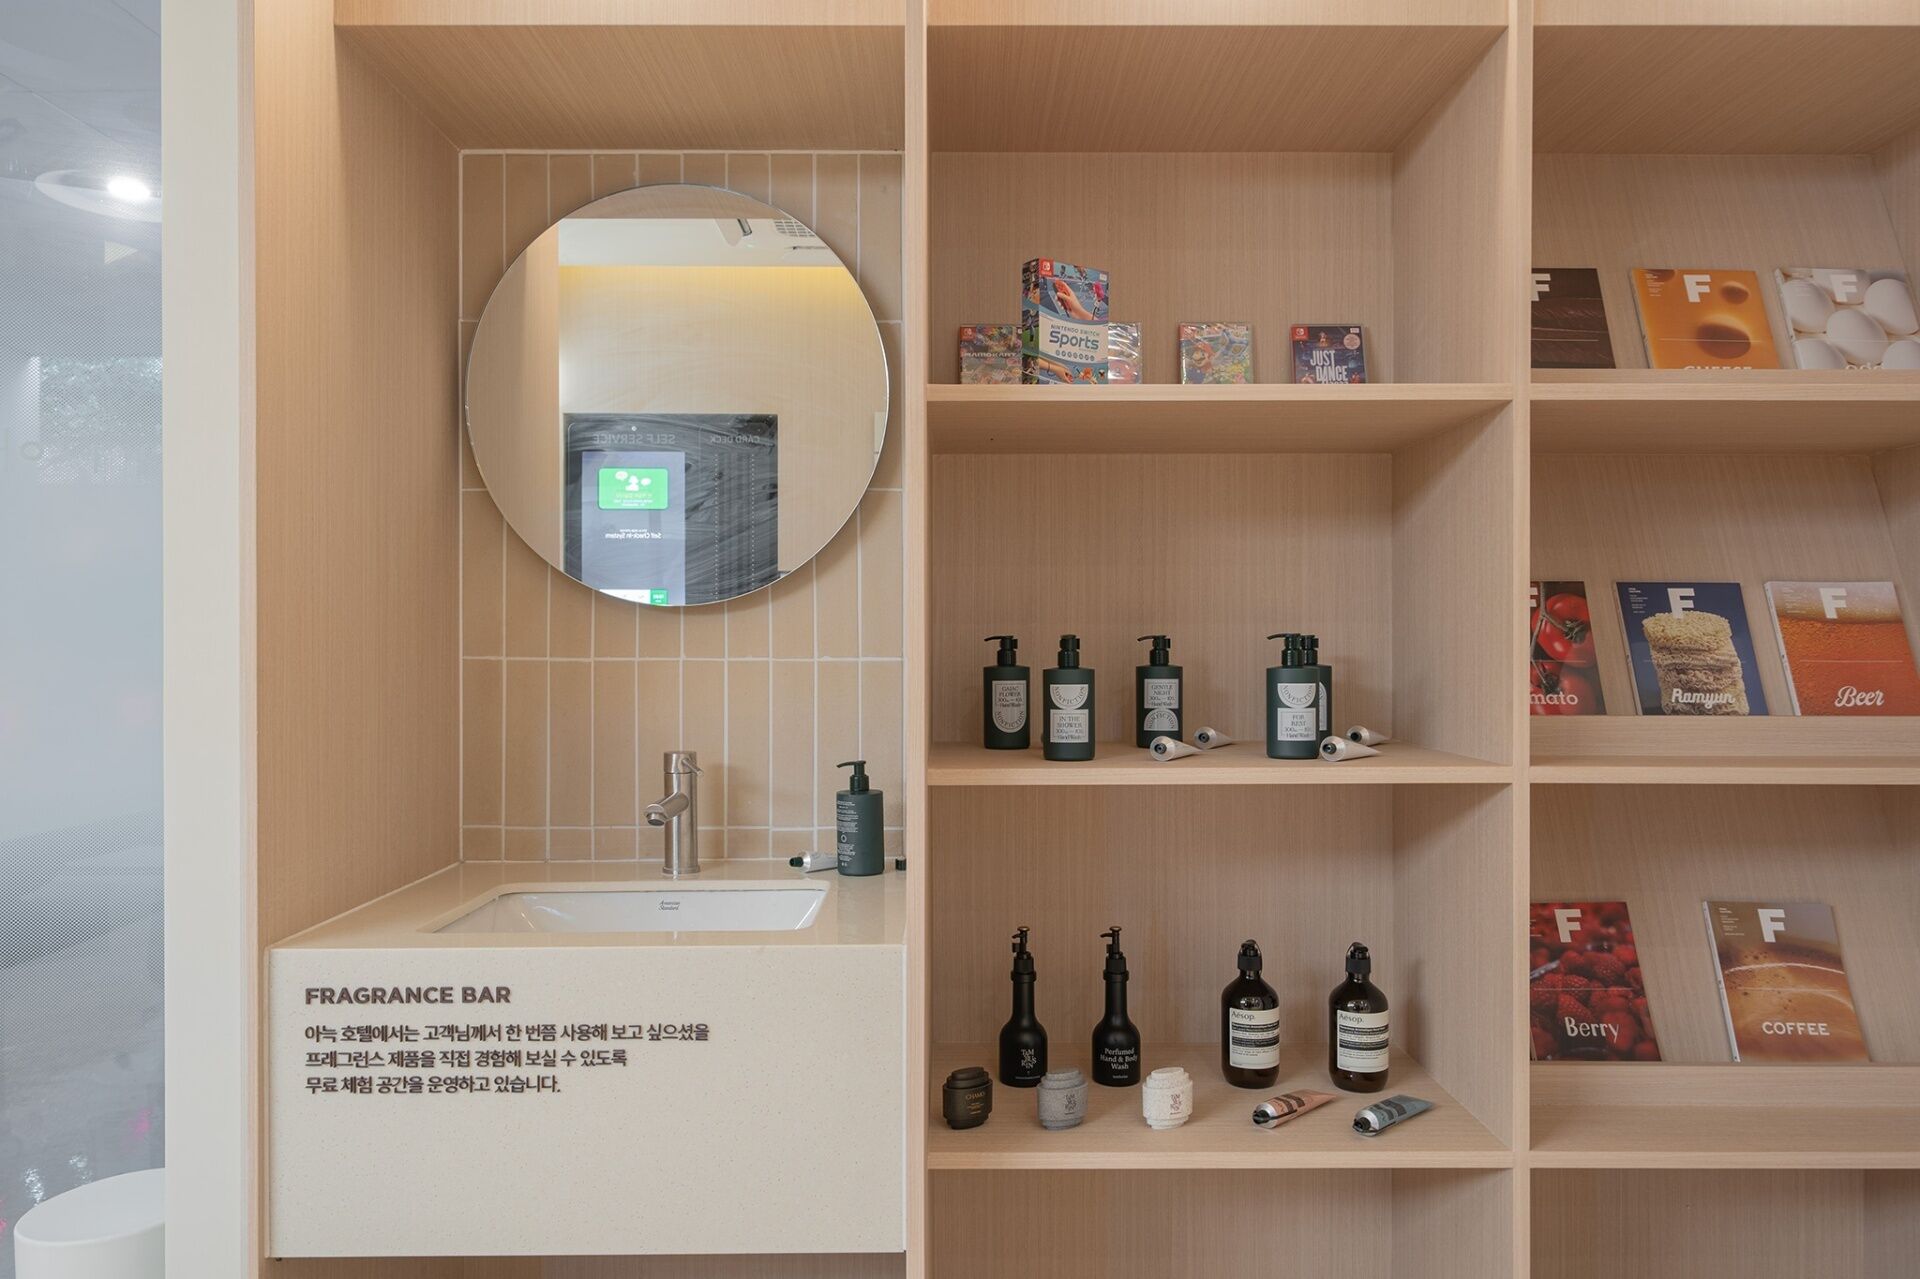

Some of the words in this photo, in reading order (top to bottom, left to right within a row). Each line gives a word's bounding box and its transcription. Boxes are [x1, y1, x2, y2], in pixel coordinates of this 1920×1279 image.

[1683, 275, 1711, 302] F
[1829, 274, 1858, 302] F
[1049, 331, 1099, 350] Sports
[1310, 350, 1335, 366] JUST
[1316, 366, 1349, 382] DANCE
[1667, 588, 1695, 619] F
[1819, 588, 1847, 619] F
[1672, 688, 1736, 709] Ramyun
[1835, 686, 1884, 707] Beer
[1554, 909, 1582, 942] F
[1757, 909, 1786, 942] F
[305, 986, 454, 1004] FRAGRANCE
[461, 986, 511, 1004] BAR
[305, 1024, 337, 1042] 아늑
[340, 1024, 420, 1042] 호텔에서는
[423, 1024, 502, 1042] 고객님께서
[505, 1024, 522, 1042] 한
[525, 1024, 557, 1042] 번쯤
[560, 1024, 608, 1042] 사용해
[611, 1024, 644, 1042] 보고
[646, 1024, 710, 1042] 싶으셨을
[1564, 1016, 1620, 1043] Berry
[1762, 1022, 1830, 1036] COFFEE
[305, 1050, 385, 1068] 프래그런스
[388, 1050, 436, 1068] 제품을
[439, 1050, 471, 1068] 직접
[474, 1050, 522, 1068] 경험해
[525, 1050, 556, 1068] 보실
[560, 1050, 577, 1068] 수
[580, 1050, 627, 1068] 있도록
[1104, 1047, 1135, 1055] Perfumed
[1111, 1062, 1129, 1070] Wash
[305, 1075, 338, 1094] 무료
[341, 1075, 373, 1094] 체험
[376, 1075, 424, 1094] 공간을
[427, 1075, 490, 1094] 운영하고
[494, 1075, 561, 1094] 있습니다.
